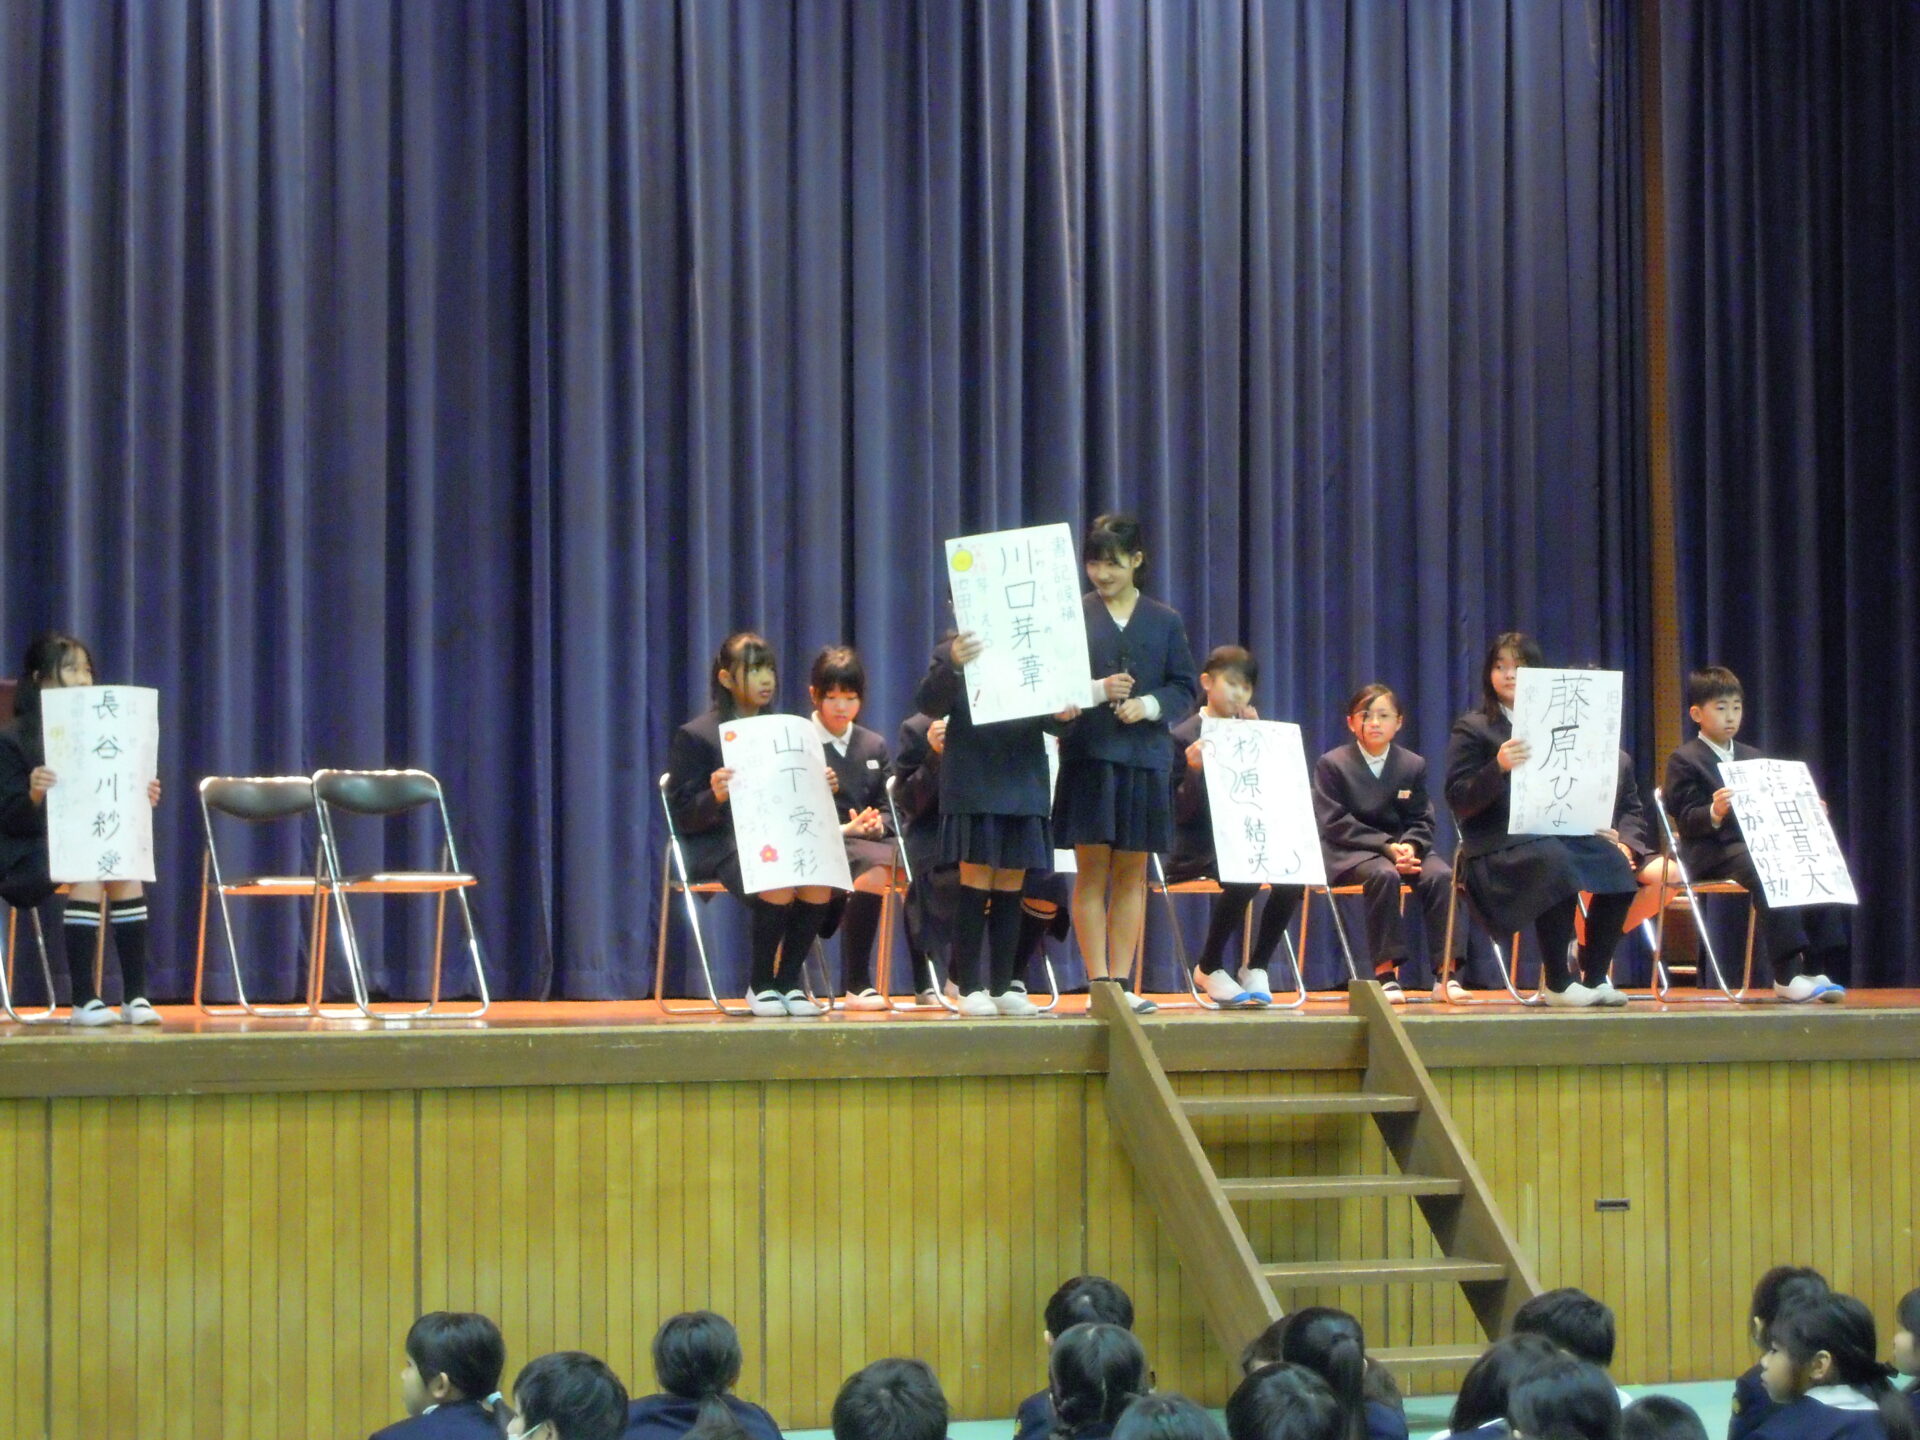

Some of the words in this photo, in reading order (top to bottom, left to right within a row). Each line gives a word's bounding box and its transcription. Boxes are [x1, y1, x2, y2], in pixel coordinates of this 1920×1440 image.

[773, 726, 819, 877] 山下愛彩
[1233, 736, 1269, 875] 杉原結咲
[1539, 674, 1593, 827] 藤原ひな
